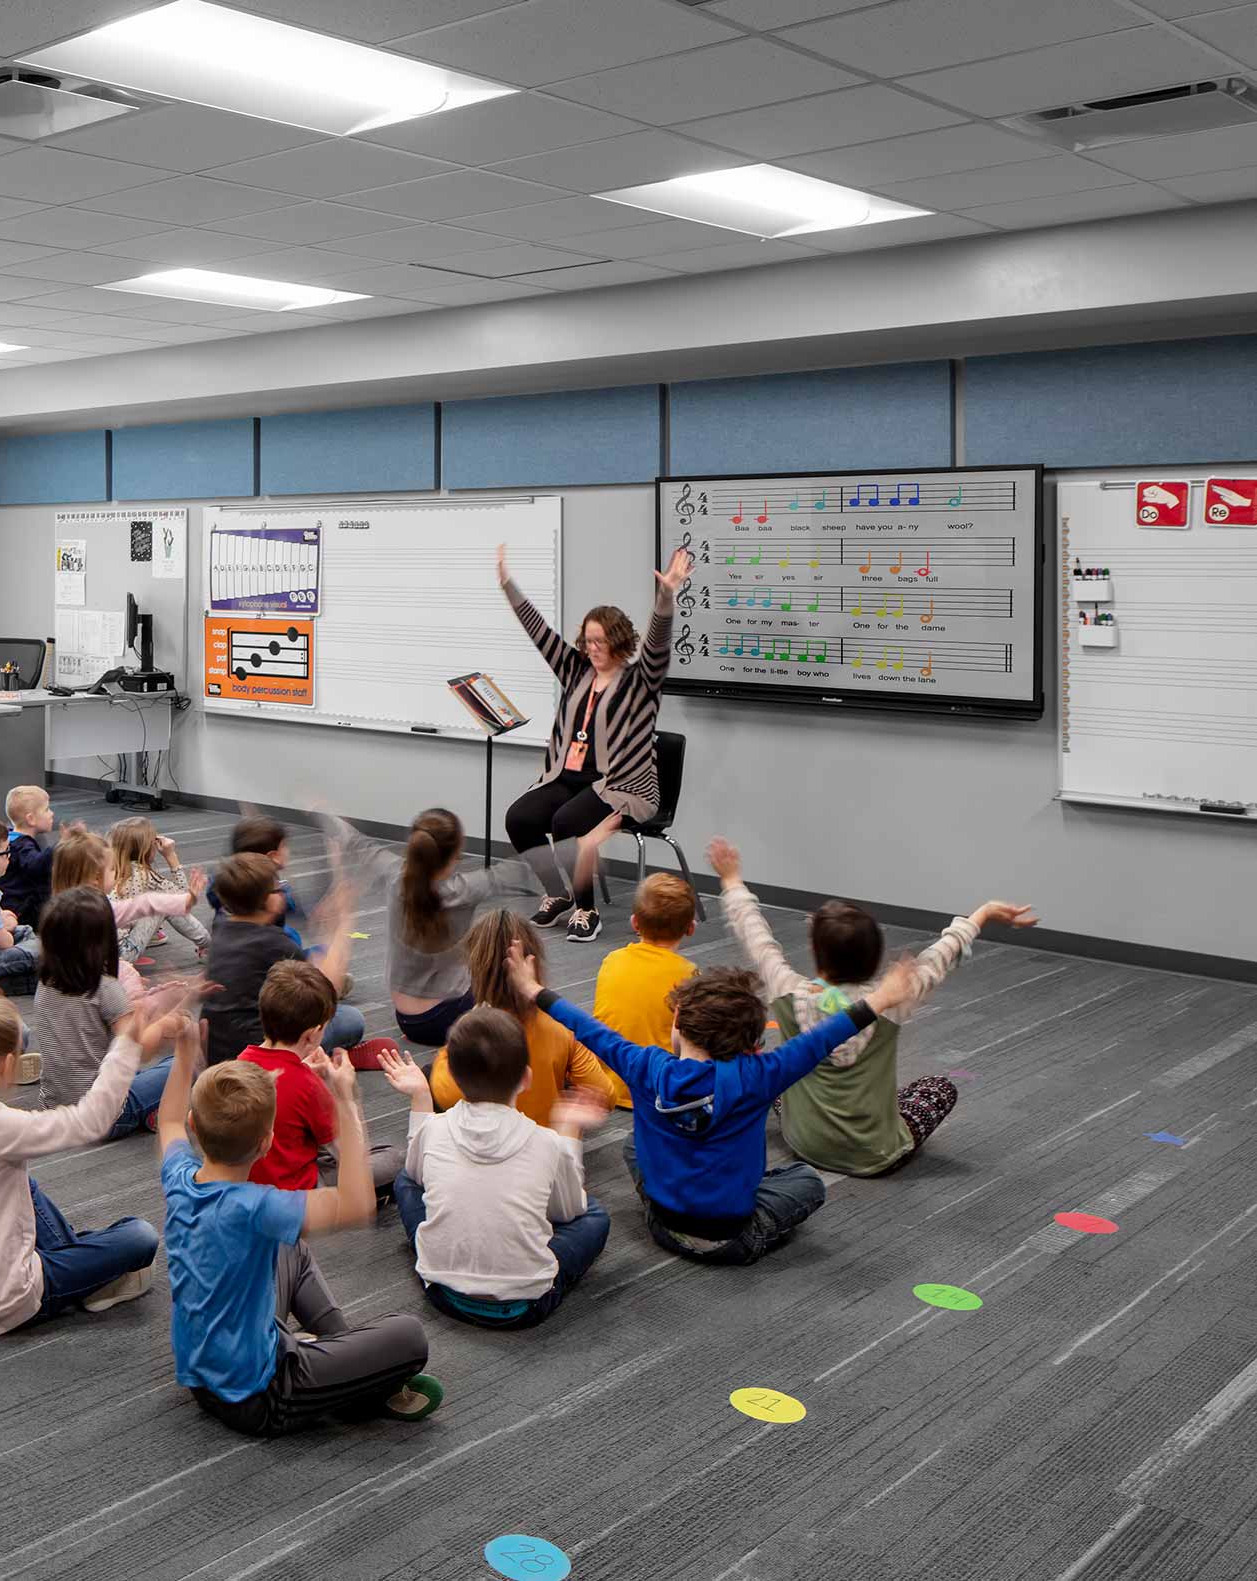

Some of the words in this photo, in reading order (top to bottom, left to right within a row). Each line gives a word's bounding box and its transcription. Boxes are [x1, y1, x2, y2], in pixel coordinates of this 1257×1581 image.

[1141, 509, 1158, 520] Do
[1212, 507, 1227, 517] Re
[823, 524, 846, 532] sheep
[761, 619, 772, 627] my
[797, 669, 811, 677] boy
[903, 675, 916, 683] the
[918, 676, 936, 684] lane
[232, 684, 249, 694] body
[252, 686, 291, 696] percussion
[292, 688, 307, 696] staff
[747, 1392, 781, 1412] 21
